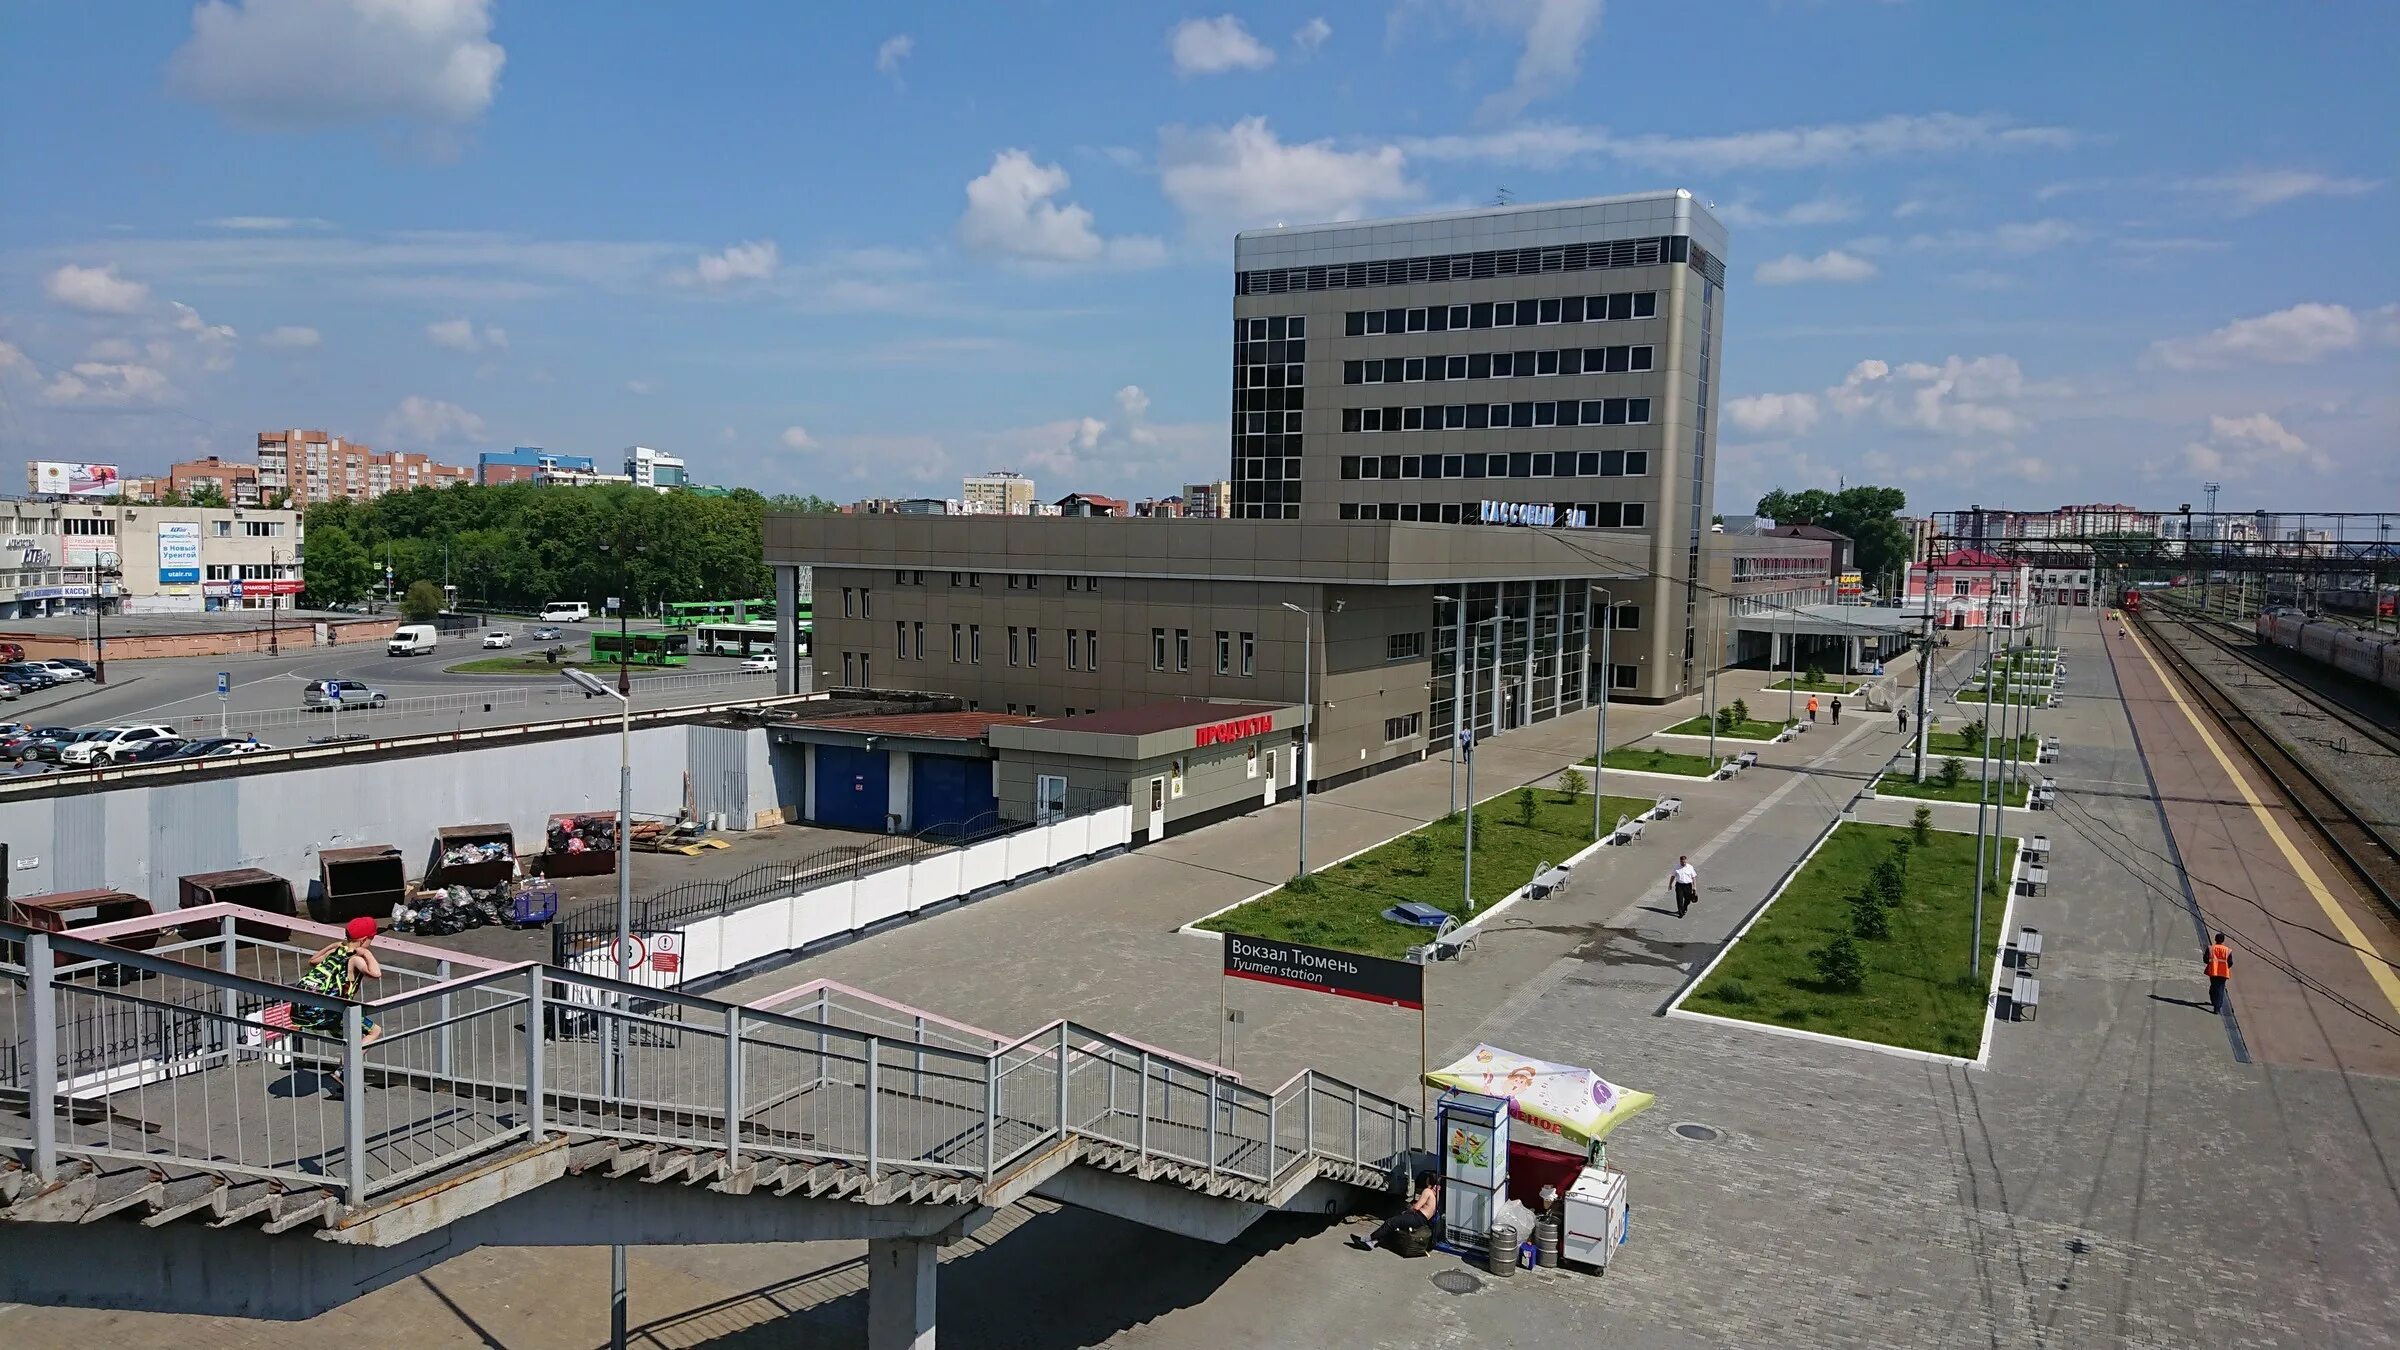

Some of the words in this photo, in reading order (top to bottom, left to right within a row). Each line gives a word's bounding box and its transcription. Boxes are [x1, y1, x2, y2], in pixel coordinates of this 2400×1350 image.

[1481, 499, 1556, 527] КАССОВЫЙ
[1566, 508, 1587, 528] ЗАЛ
[163, 551, 197, 560] Уренгой
[64, 587, 90, 595] КАССЫ
[331, 683, 338, 696] P
[1196, 715, 1273, 747] ПРОДУКТЫ
[1232, 939, 1288, 962] Вокзал
[1292, 949, 1358, 975] Тюмень
[1232, 957, 1278, 975] Tyumen
[1280, 966, 1323, 983] station
